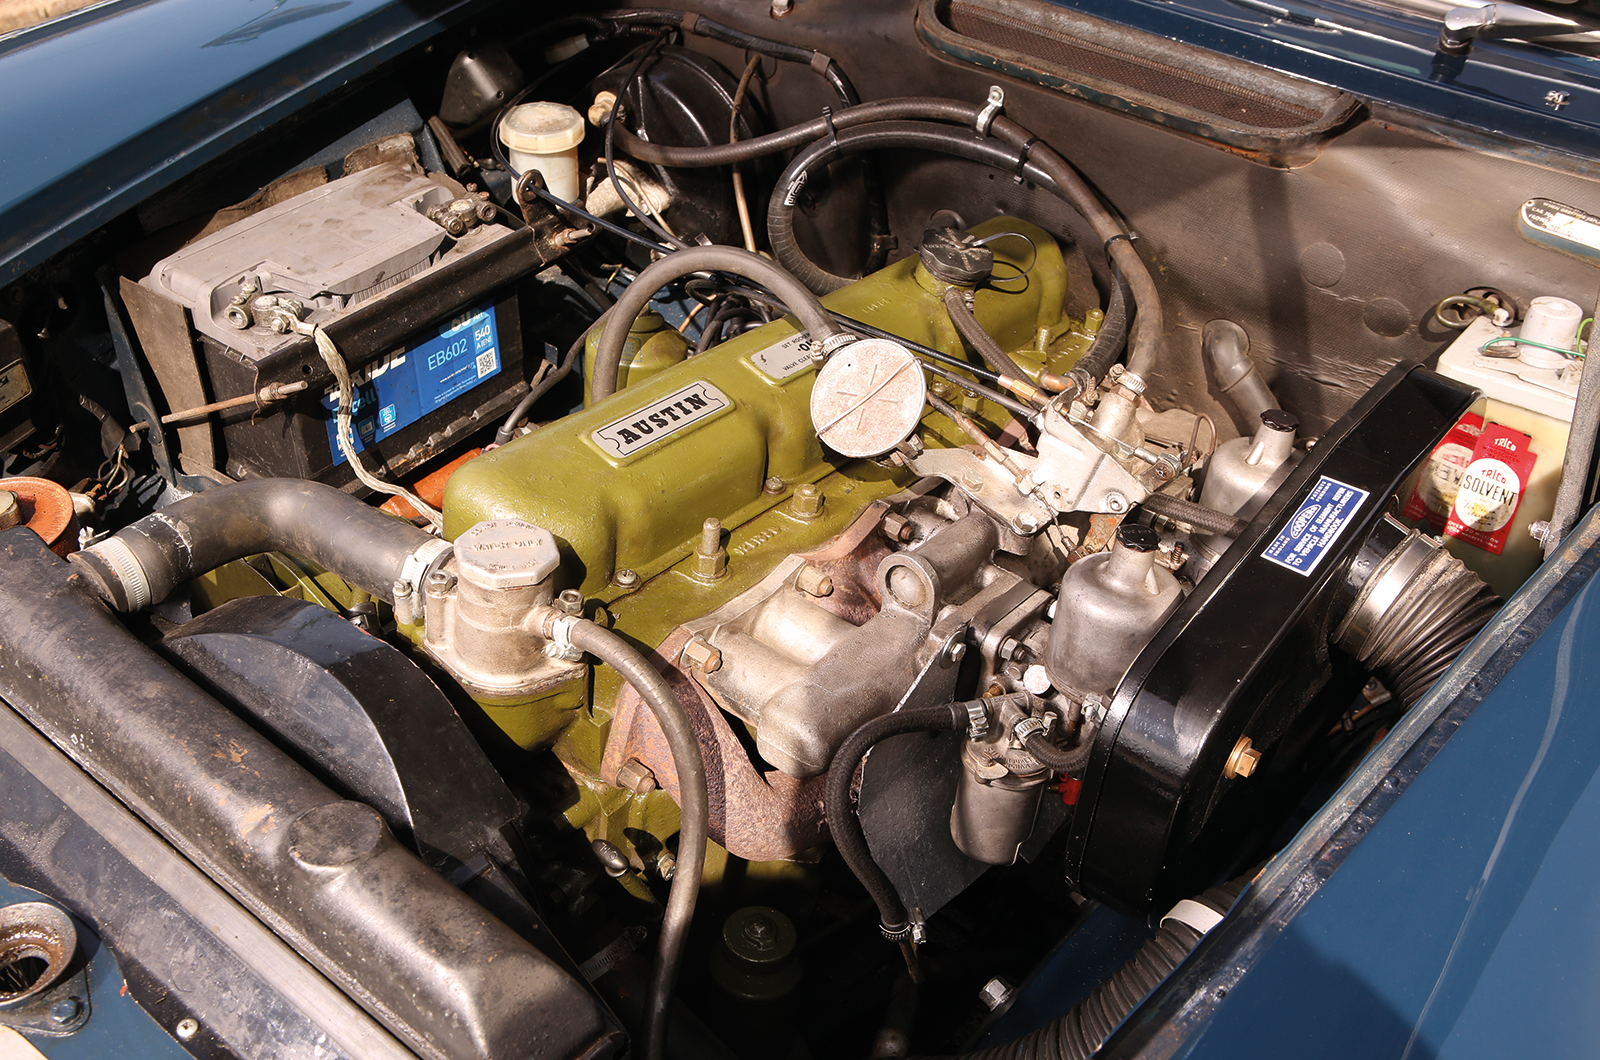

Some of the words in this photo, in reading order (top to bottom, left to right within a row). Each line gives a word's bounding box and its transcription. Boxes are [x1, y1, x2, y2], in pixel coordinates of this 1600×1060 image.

[474, 324, 490, 341] 540
[427, 338, 468, 371] EB602
[782, 361, 798, 370] VALVE
[617, 393, 708, 445] AUSTIN
[1494, 437, 1517, 451] TRICO
[1482, 446, 1520, 463] WINDSCREEN
[1481, 468, 1507, 484] TRICO
[1315, 482, 1332, 502] PENDING
[1463, 474, 1517, 506] SOLVENT
[1284, 552, 1297, 563] FOR
[1294, 532, 1312, 552] SERVICE
[1309, 524, 1318, 532] OF
[1315, 502, 1334, 524] ELEMENT
[1332, 486, 1346, 501] REFER
[1293, 506, 1318, 536] COOPERS
[1448, 520, 1463, 530] OVER
[1272, 537, 1290, 556] ENGLAND
[1292, 557, 1303, 566] TO
[1299, 535, 1320, 556] VEHICLE
